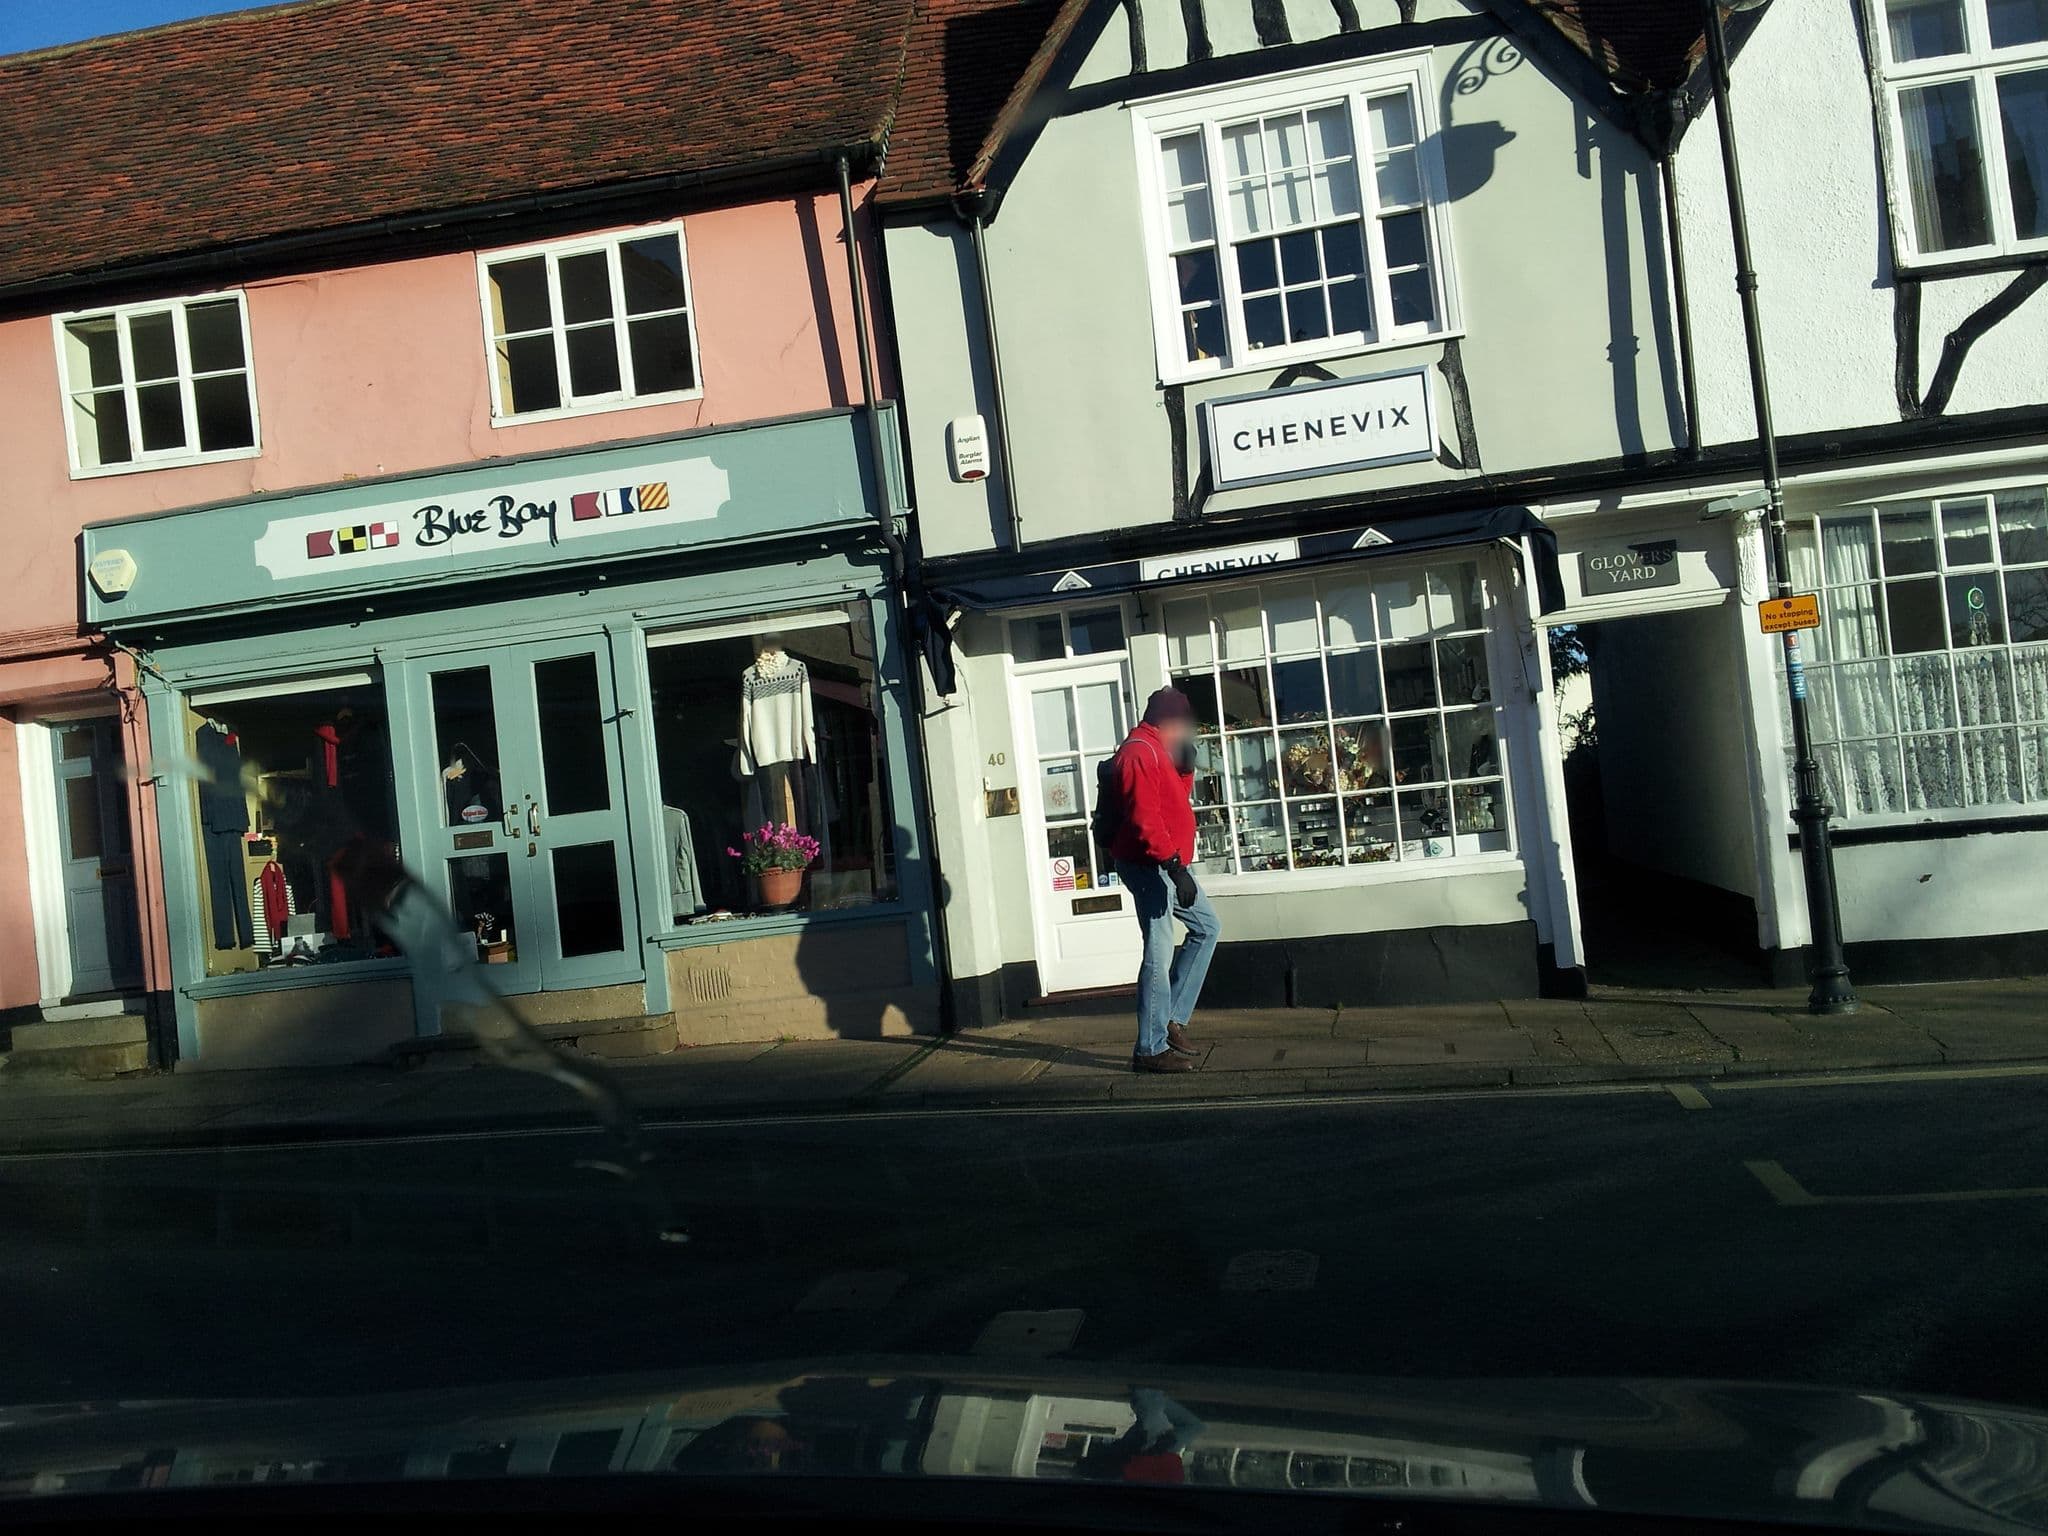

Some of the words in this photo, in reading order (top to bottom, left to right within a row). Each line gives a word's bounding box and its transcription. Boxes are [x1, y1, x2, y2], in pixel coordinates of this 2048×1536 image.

[1232, 405, 1411, 451] CHENEVIX
[413, 504, 491, 547] Blue
[488, 495, 559, 548] Bay
[1590, 548, 1673, 571] GLOVERS
[1608, 566, 1657, 583] YARD
[1765, 612, 1777, 620] No
[1780, 608, 1814, 619] stopping
[1764, 622, 1791, 631] except
[1793, 618, 1817, 626] buses
[988, 752, 1006, 766] 40
